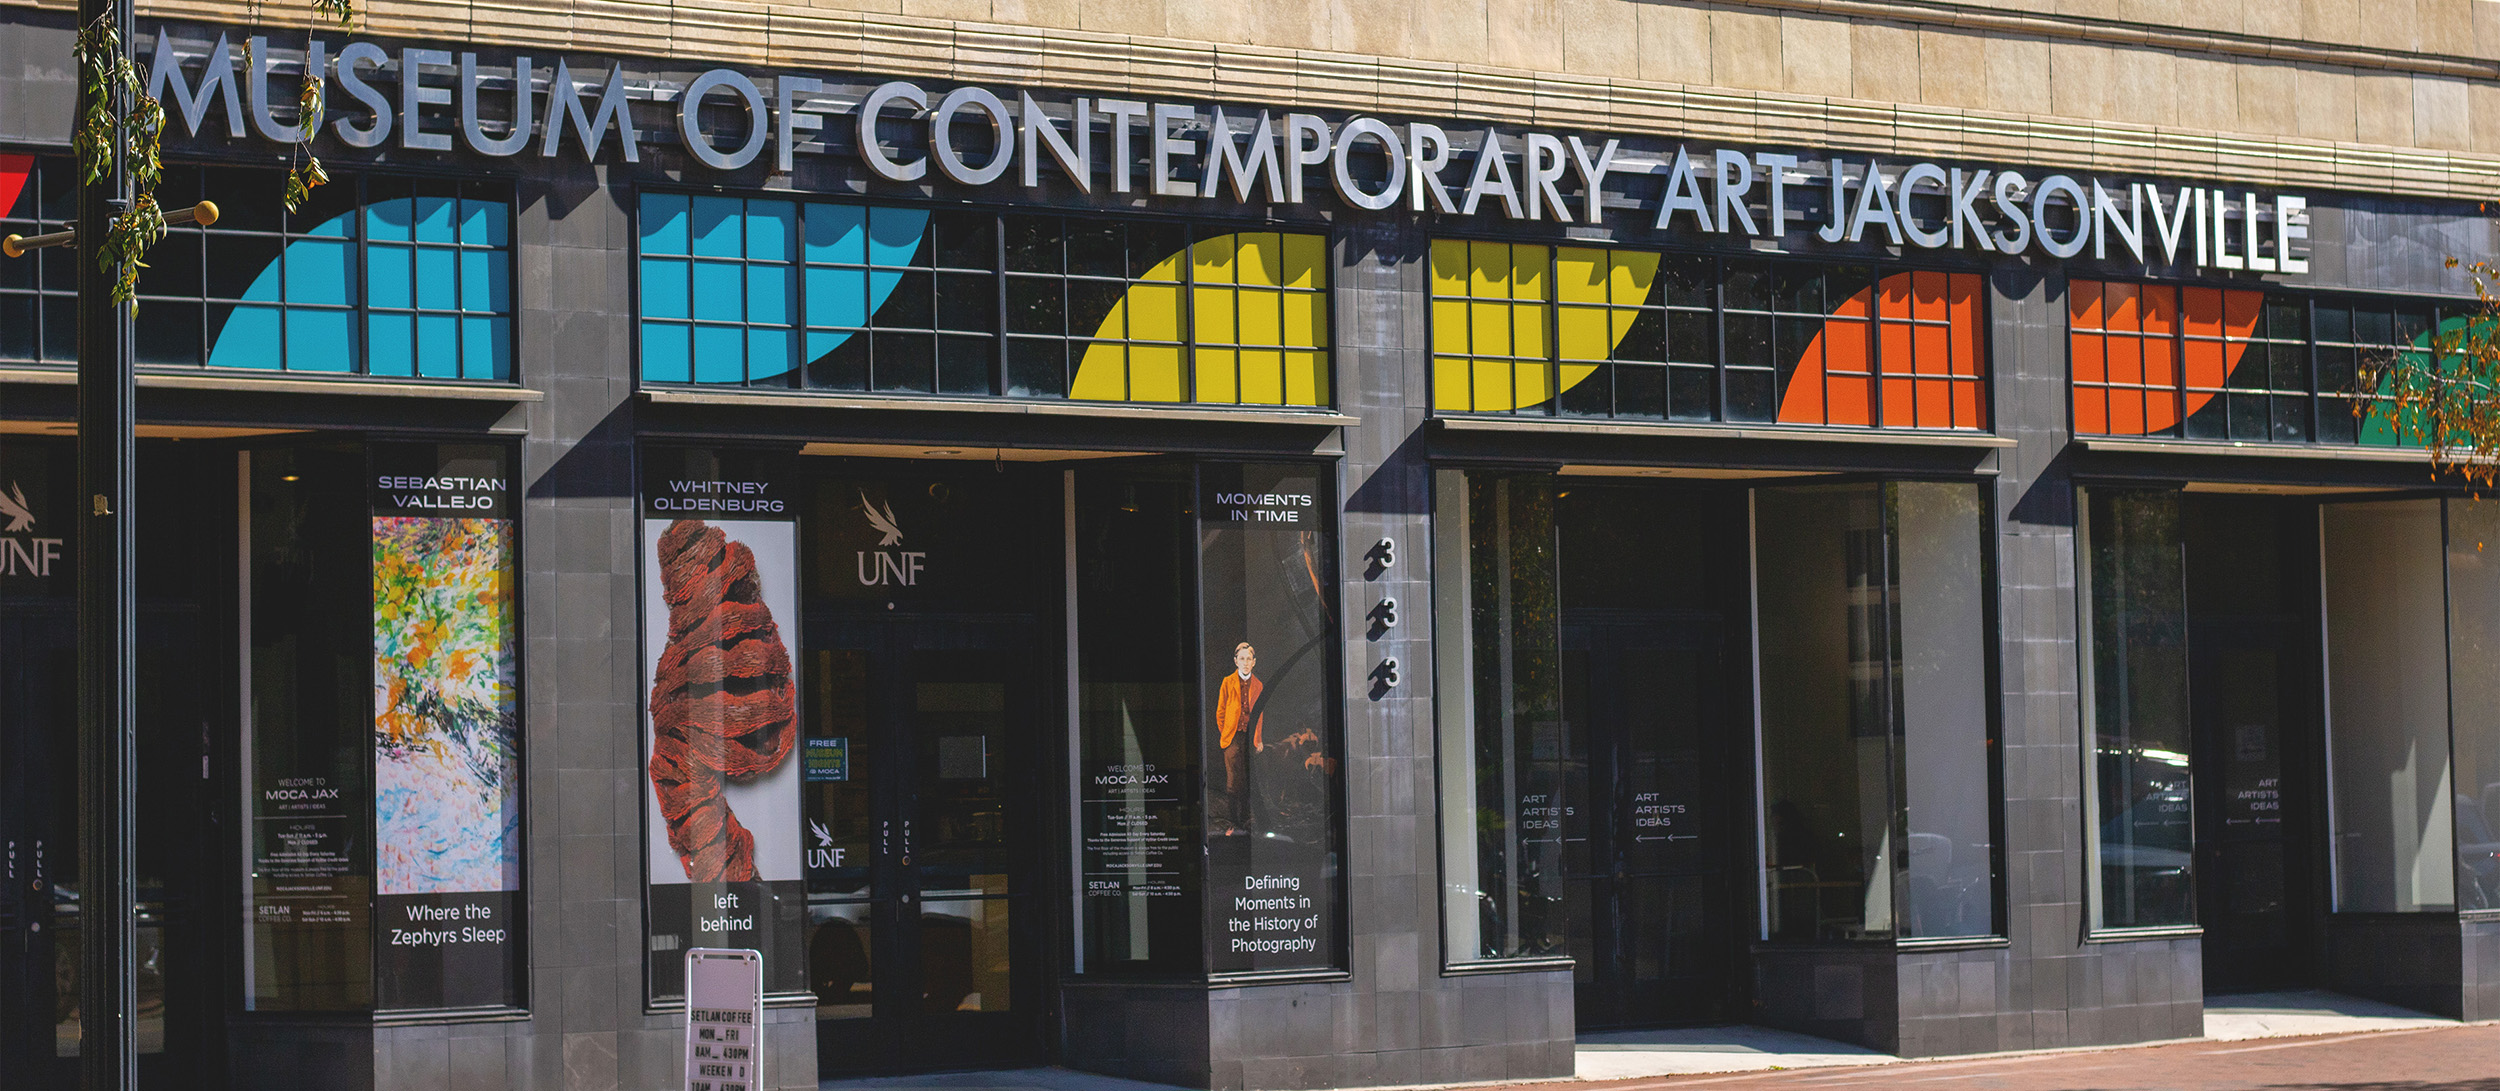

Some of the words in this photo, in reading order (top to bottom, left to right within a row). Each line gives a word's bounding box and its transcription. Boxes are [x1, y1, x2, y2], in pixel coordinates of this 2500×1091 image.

[146, 25, 639, 164] MUSEUM
[677, 68, 823, 172] OF
[857, 82, 1619, 226] CONTEMPORARY
[1655, 144, 1798, 237] ART
[1818, 157, 2309, 274] JACKSONVILLE
[378, 476, 507, 491] SEBASTIAN
[669, 480, 769, 494] WHITNEY
[392, 494, 493, 510] VALLEJO
[654, 498, 784, 512] OLDENBURG
[1216, 493, 1312, 507] MOMENTS
[1231, 509, 1248, 521] IN
[1254, 510, 1299, 522] TIME
[0, 537, 63, 578] NF
[857, 551, 926, 586] UNF
[809, 739, 837, 747] FREE
[1107, 764, 1144, 772] WELCOME
[1146, 764, 1155, 772] TO
[278, 778, 314, 786] WELCOME
[316, 777, 326, 786] TO
[1095, 775, 1138, 784] MOCA
[1141, 775, 1169, 784] JAX
[2258, 778, 2278, 787] ART
[265, 789, 308, 800] MOCA
[311, 789, 339, 799] JAX
[1522, 794, 1547, 804] ART
[1635, 793, 1659, 802] ART
[2238, 789, 2279, 799] ARTISTS
[1635, 805, 1686, 814] ARTISTS
[2159, 803, 2187, 812] IDEAS
[2250, 801, 2279, 811] IDEAS
[1523, 820, 1559, 829] IDEAS
[1636, 817, 1671, 827] IDEAS
[807, 848, 845, 868] UNF
[1089, 881, 1120, 889] SETLAN
[1245, 874, 1300, 891] Defining
[714, 893, 739, 909] left
[1235, 896, 1296, 911] Moments
[1299, 894, 1311, 908] in
[259, 905, 290, 914] SETLAN
[406, 905, 460, 921] Where
[465, 904, 491, 919] the
[701, 915, 753, 932] behind
[1229, 917, 1251, 932] the
[1254, 916, 1300, 932] History
[1304, 914, 1318, 929] of
[391, 927, 457, 947] Zephyrs
[462, 926, 506, 944] Sleep
[1231, 935, 1316, 953] Photography
[699, 1028, 715, 1040] MON
[725, 1029, 739, 1041] FRI
[695, 1046, 711, 1058] 8AM
[723, 1047, 749, 1060] 430PM
